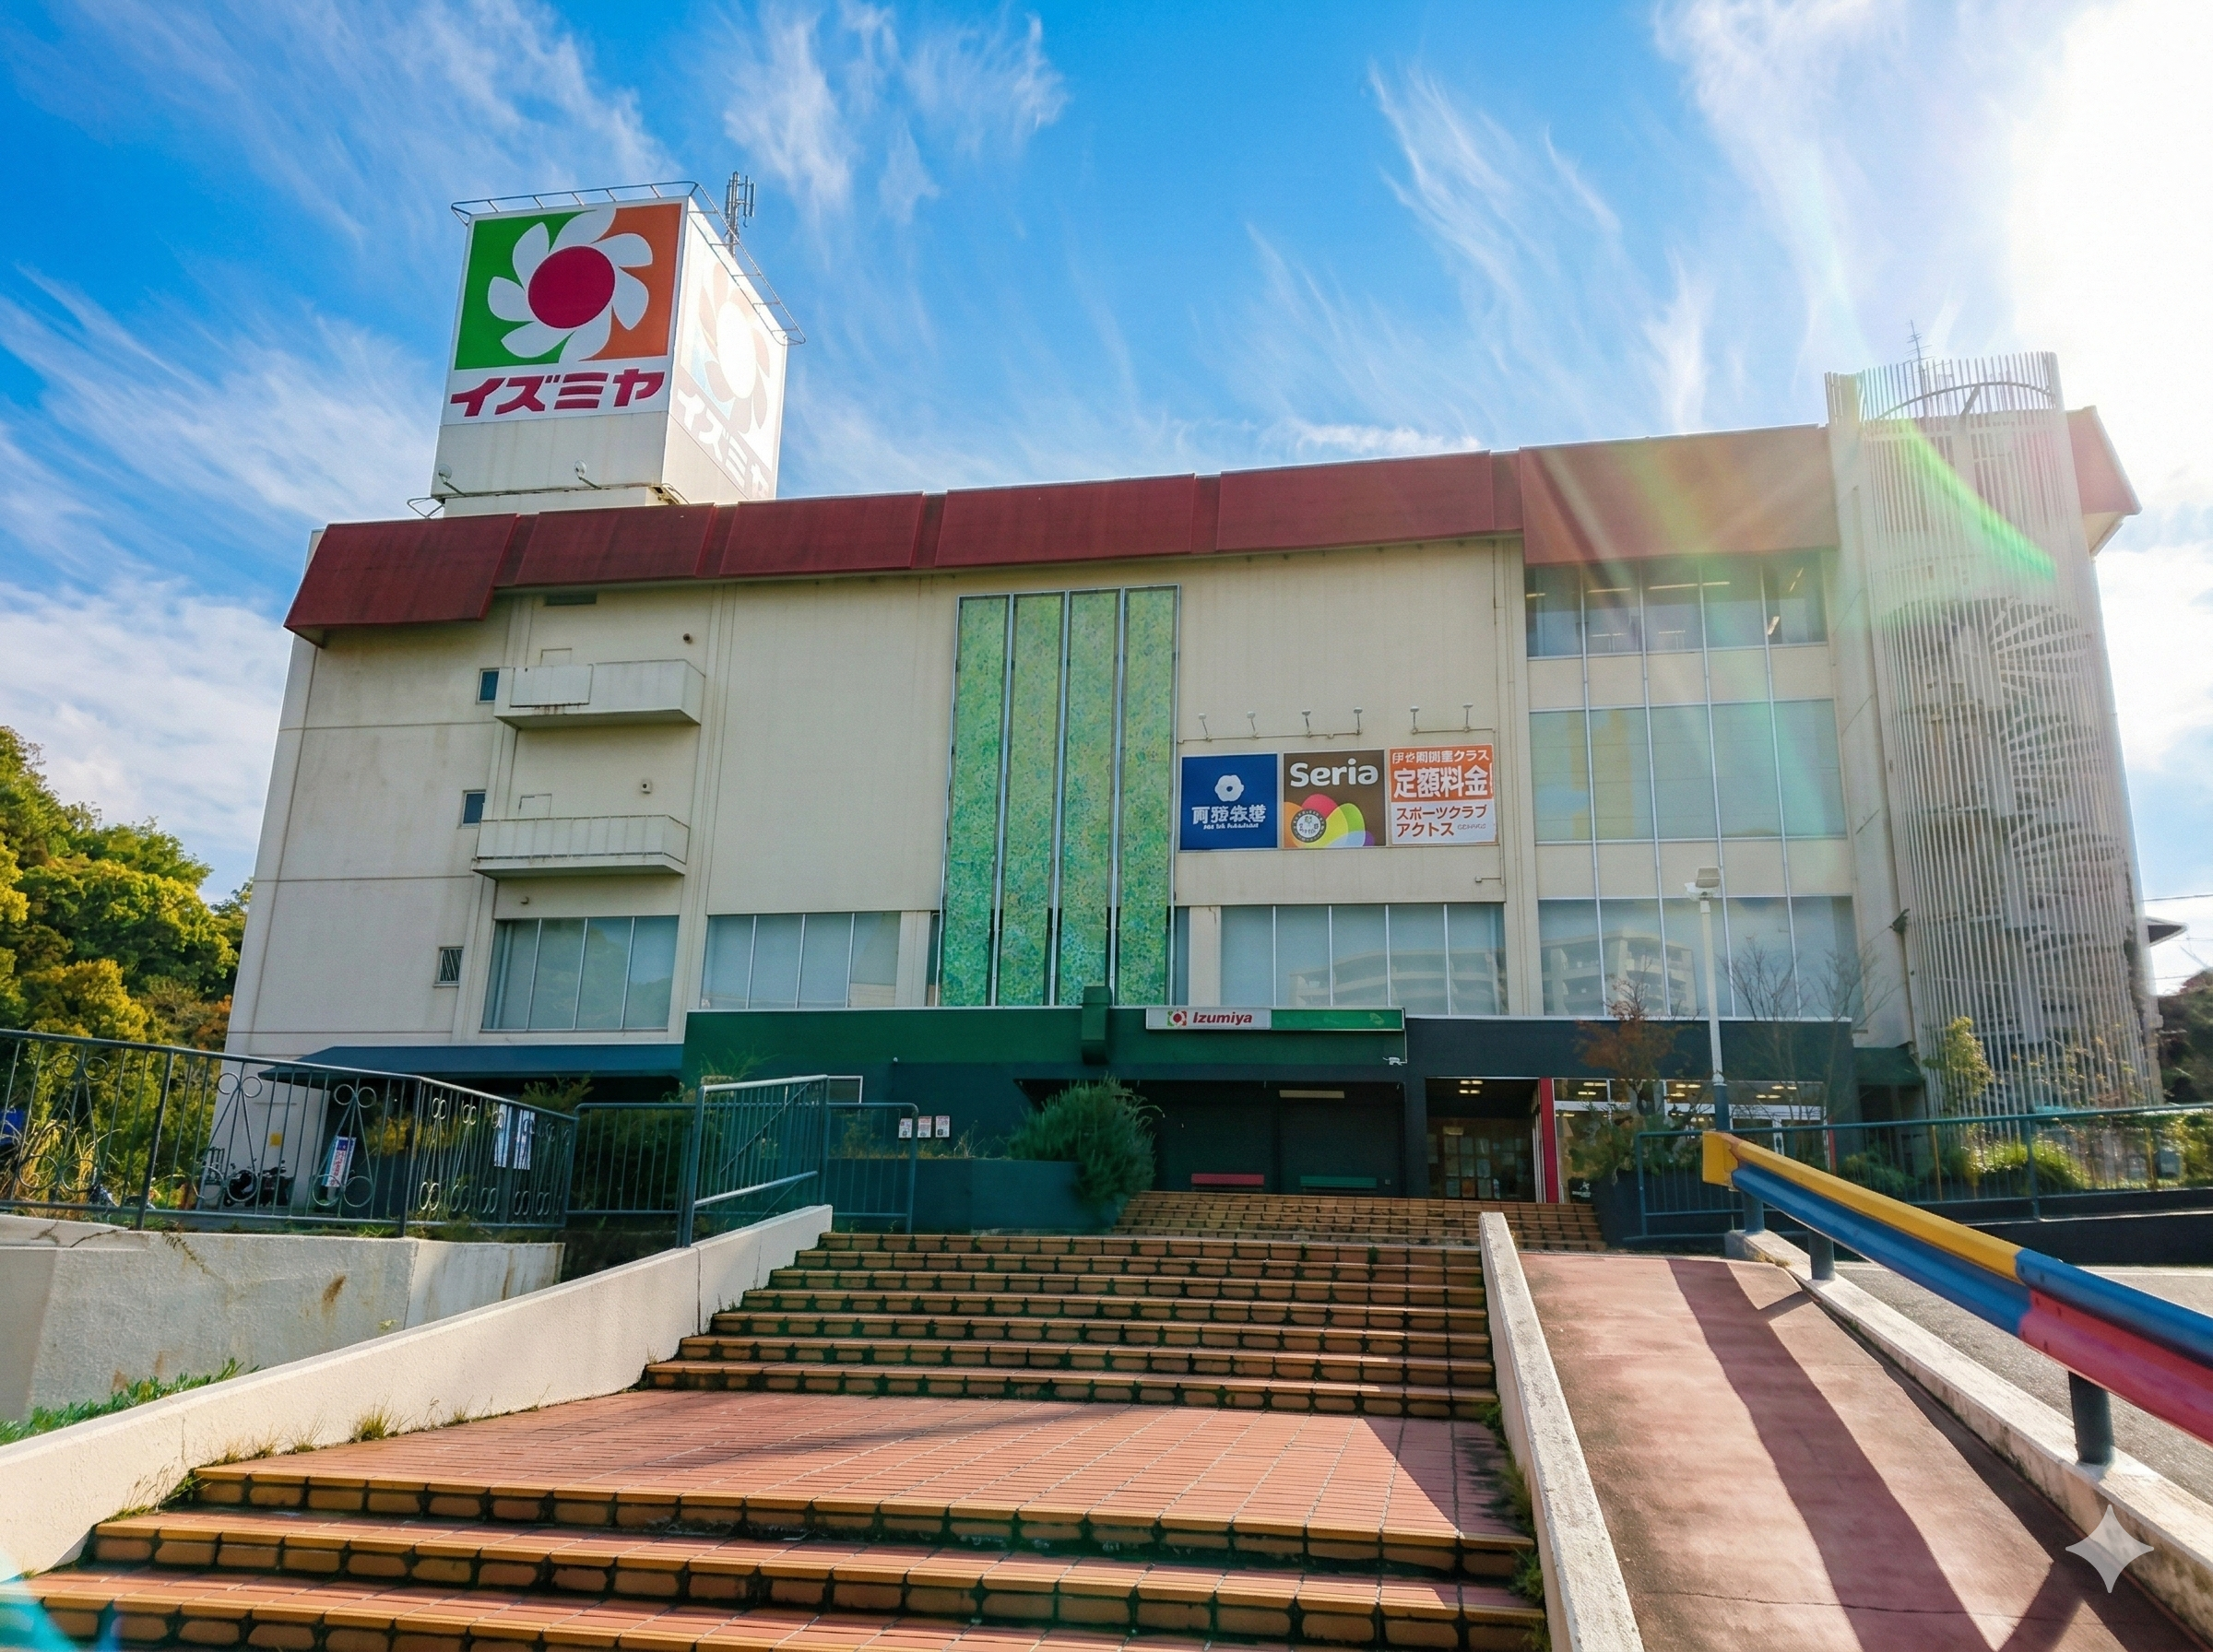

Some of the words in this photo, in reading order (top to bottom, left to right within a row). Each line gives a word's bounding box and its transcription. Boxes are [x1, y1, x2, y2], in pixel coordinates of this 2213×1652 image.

[450, 368, 665, 418] イズミヤ
[676, 388, 770, 499] イズミヤ
[1290, 758, 1379, 788] Seria
[1396, 804, 1487, 820] スポーツクラブ
[1396, 821, 1454, 838] アクトス
[1192, 1011, 1253, 1027] Izumiya
